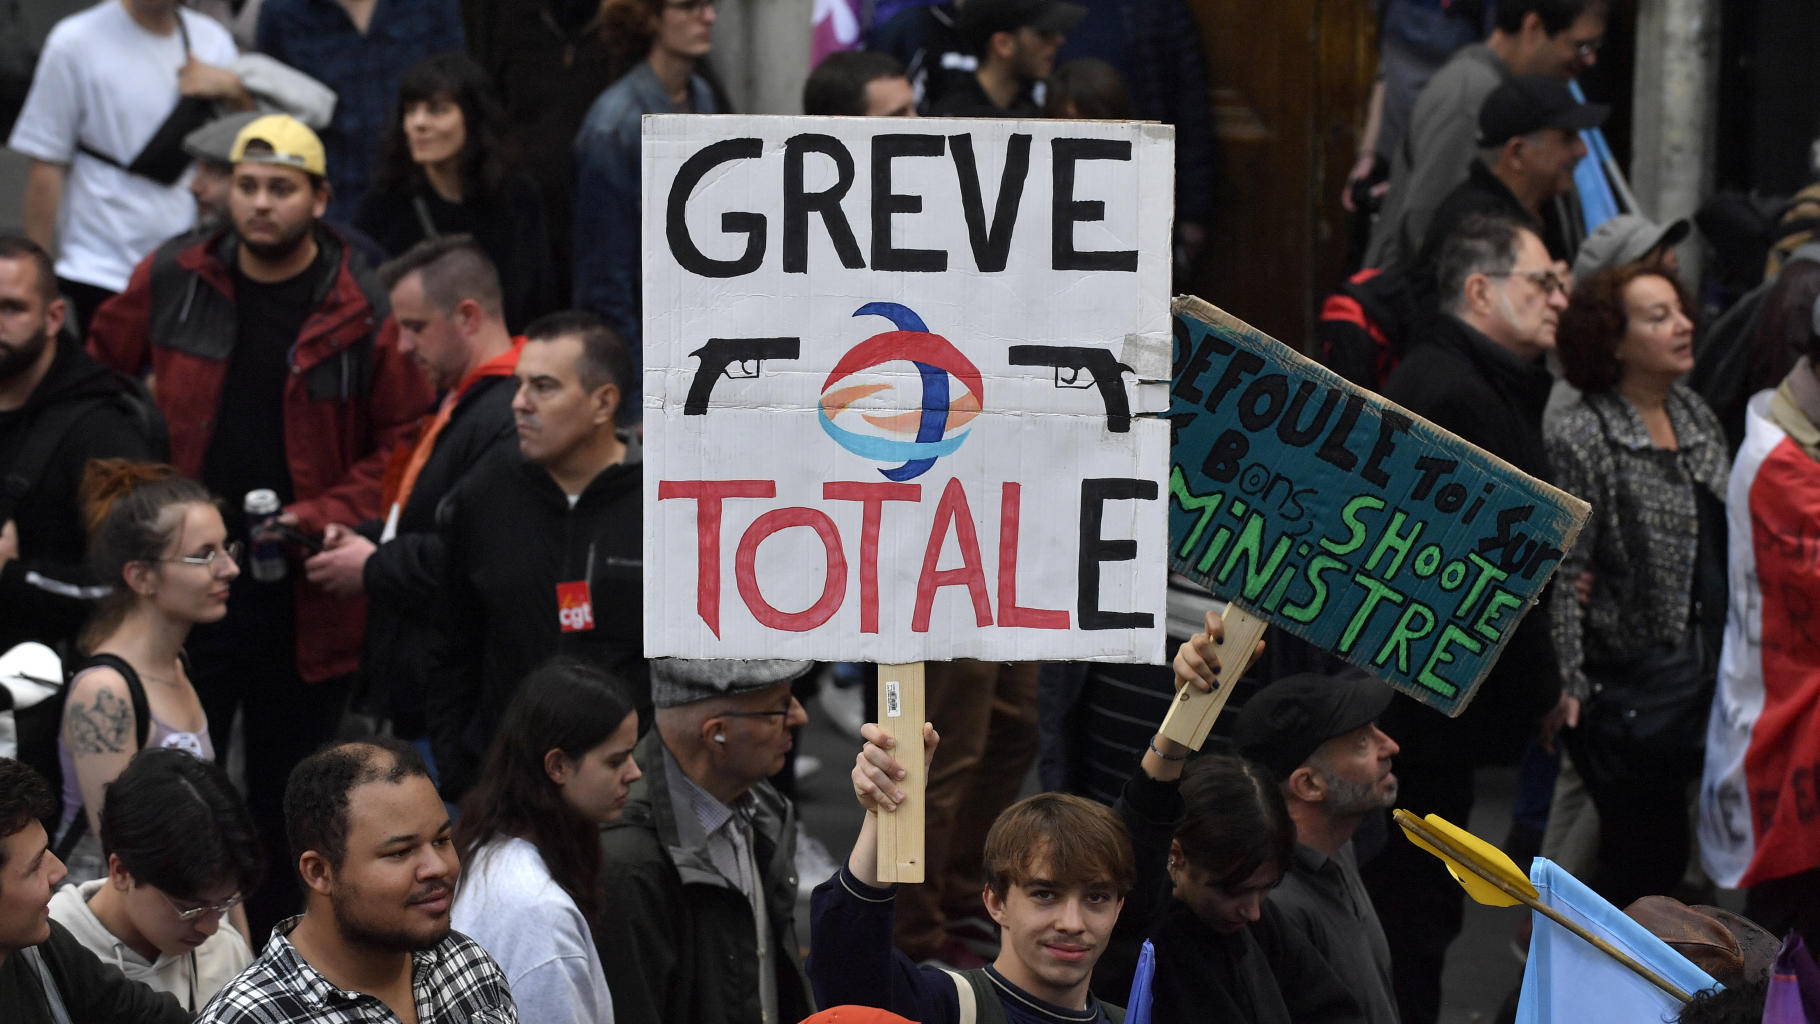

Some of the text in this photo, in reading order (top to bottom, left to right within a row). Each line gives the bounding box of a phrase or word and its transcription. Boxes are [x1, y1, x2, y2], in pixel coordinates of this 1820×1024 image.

[666, 133, 1138, 278] GREVE
[1478, 505, 1564, 580] Sur
[560, 602, 592, 629] cgt
